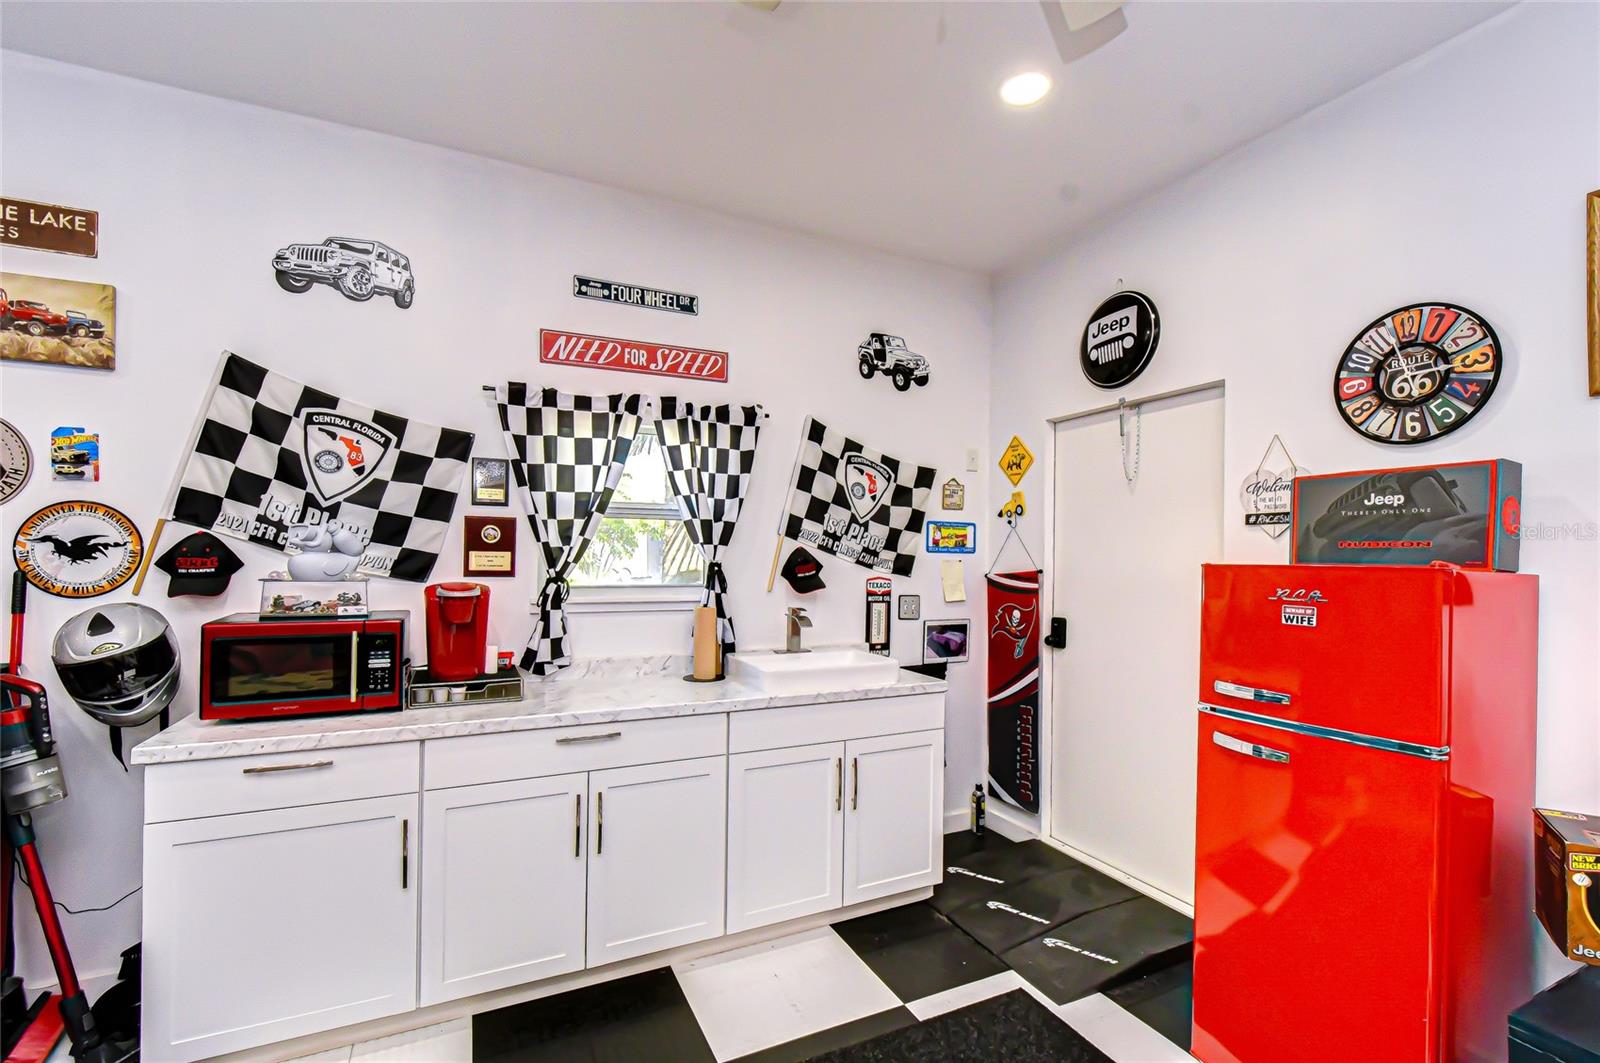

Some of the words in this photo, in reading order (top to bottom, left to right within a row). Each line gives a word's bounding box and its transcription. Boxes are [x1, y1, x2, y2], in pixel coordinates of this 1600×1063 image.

[30, 209, 86, 232] LAKE
[611, 284, 643, 304] FOUR
[644, 290, 681, 310] WHEEL
[680, 296, 690, 306] DR
[1092, 315, 1130, 339] Jeep
[1400, 314, 1415, 339] 12
[1429, 312, 1446, 338] 1
[1450, 326, 1478, 348] 2
[1366, 328, 1393, 353] 11
[547, 335, 622, 364] NEED
[624, 348, 647, 366] FOR
[650, 348, 722, 376] SPEED
[1348, 353, 1374, 372] 10
[1391, 353, 1429, 369] ROUTE
[1460, 351, 1491, 369] 3
[1343, 379, 1367, 394] 9
[1392, 373, 1432, 398] 66
[1452, 381, 1480, 398] 4
[1351, 400, 1373, 418] 8
[1375, 408, 1395, 432] 7
[1429, 398, 1456, 423] 5
[312, 415, 351, 428] CENTRAL
[352, 422, 386, 444] FLORIDA
[1405, 411, 1420, 436] 6
[350, 451, 362, 460] 83
[1245, 477, 1290, 497] Welcom
[260, 493, 300, 527] 1st
[1364, 493, 1405, 507] Jeep
[28, 504, 75, 532] SURVIVED
[79, 504, 100, 514] THE
[102, 508, 133, 537] DRAGON
[216, 512, 250, 534] 2021
[250, 521, 277, 541] CFR
[360, 553, 395, 572] PION
[824, 513, 847, 537] 1st
[847, 523, 886, 553] Place
[1337, 541, 1433, 549] RUBICON
[819, 535, 834, 549] CFR
[833, 541, 860, 560] CLASS
[859, 552, 893, 571] CHAMPION
[25, 564, 56, 590] CURVES
[72, 584, 105, 594] MILES
[107, 566, 132, 585] DEALS
[128, 549, 138, 567] GAP
[1284, 615, 1314, 625] WIFE
[1572, 855, 1596, 863] NEW
